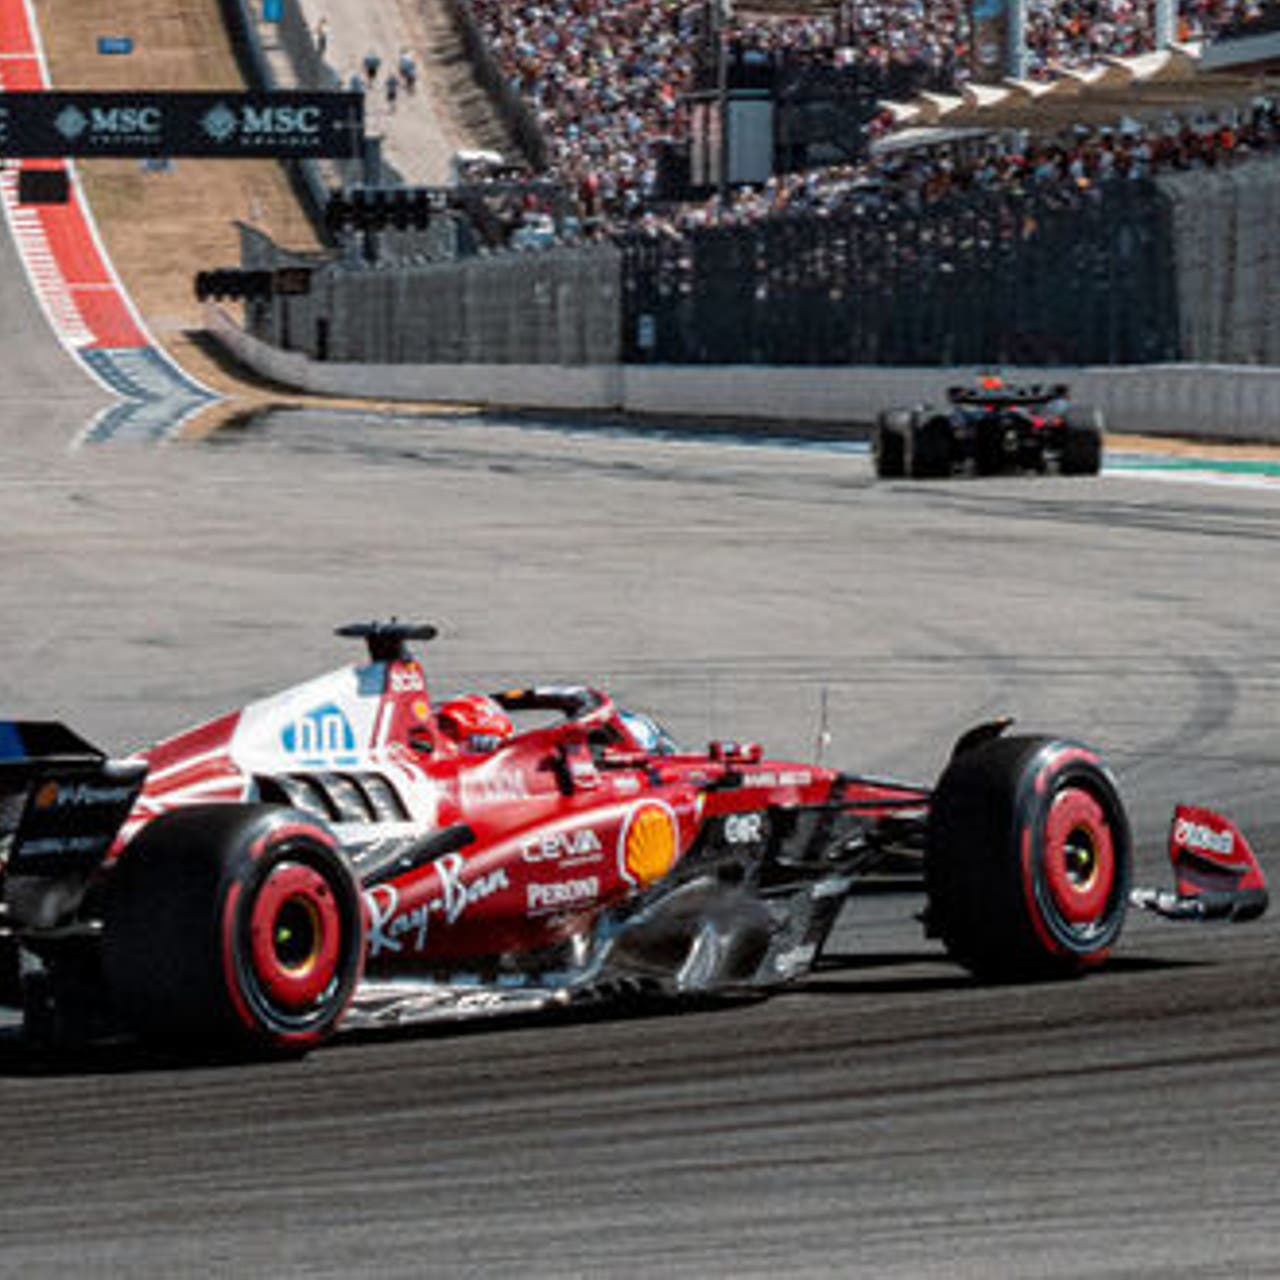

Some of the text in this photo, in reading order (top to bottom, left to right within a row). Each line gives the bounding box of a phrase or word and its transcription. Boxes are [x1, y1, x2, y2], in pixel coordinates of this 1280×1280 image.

[90, 107, 162, 132] MSC
[242, 106, 321, 133] MSC
[364, 851, 510, 956] Ray-Ban
